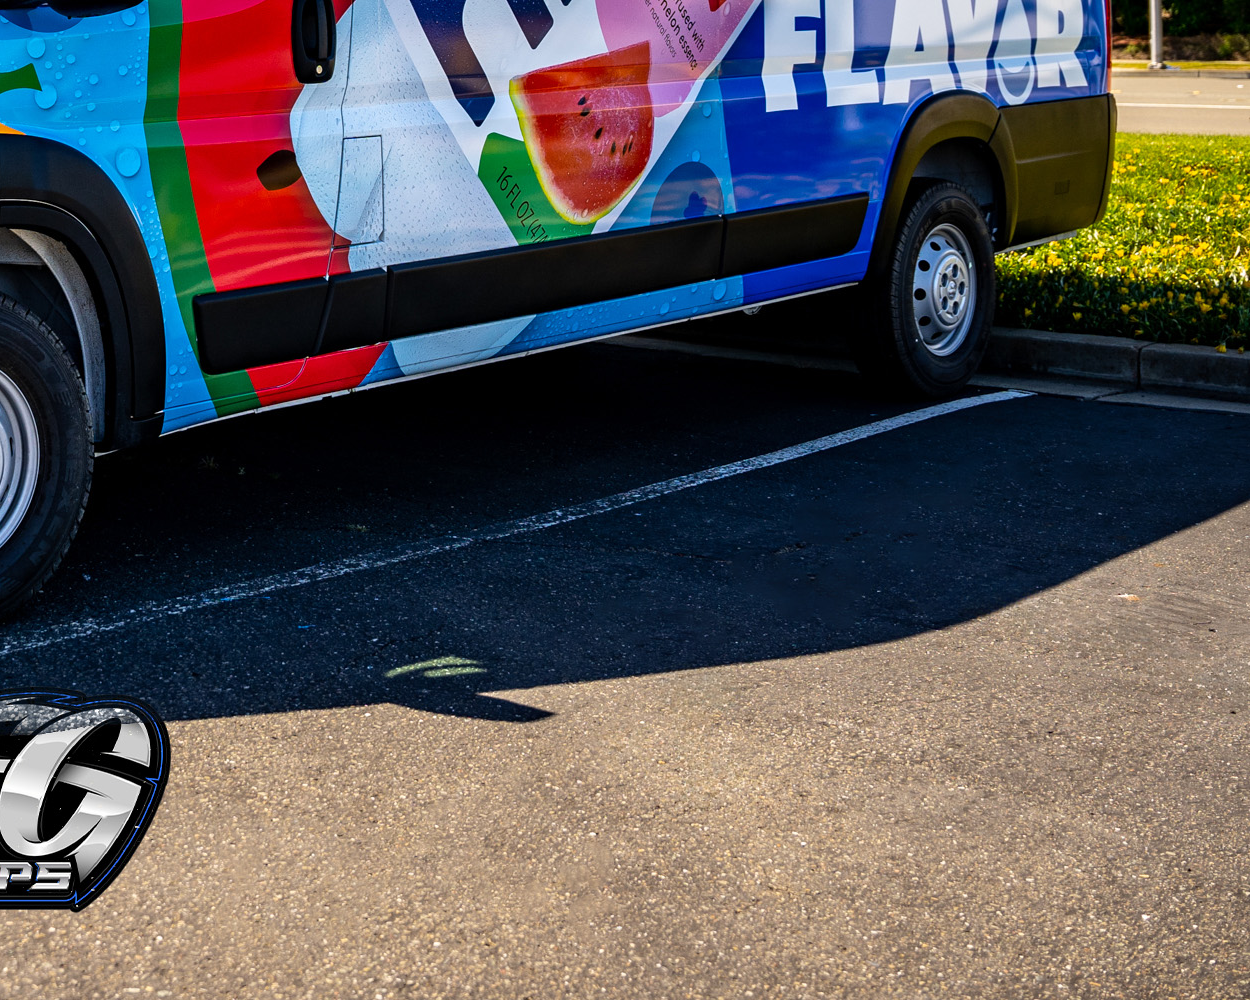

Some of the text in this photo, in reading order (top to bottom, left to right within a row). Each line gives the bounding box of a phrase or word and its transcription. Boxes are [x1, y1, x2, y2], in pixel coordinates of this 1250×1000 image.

[650, 6, 667, 36] natural
[691, 31, 704, 53] with
[496, 166, 513, 191] 16
[506, 183, 522, 209] FL
[516, 201, 535, 227] OZ
